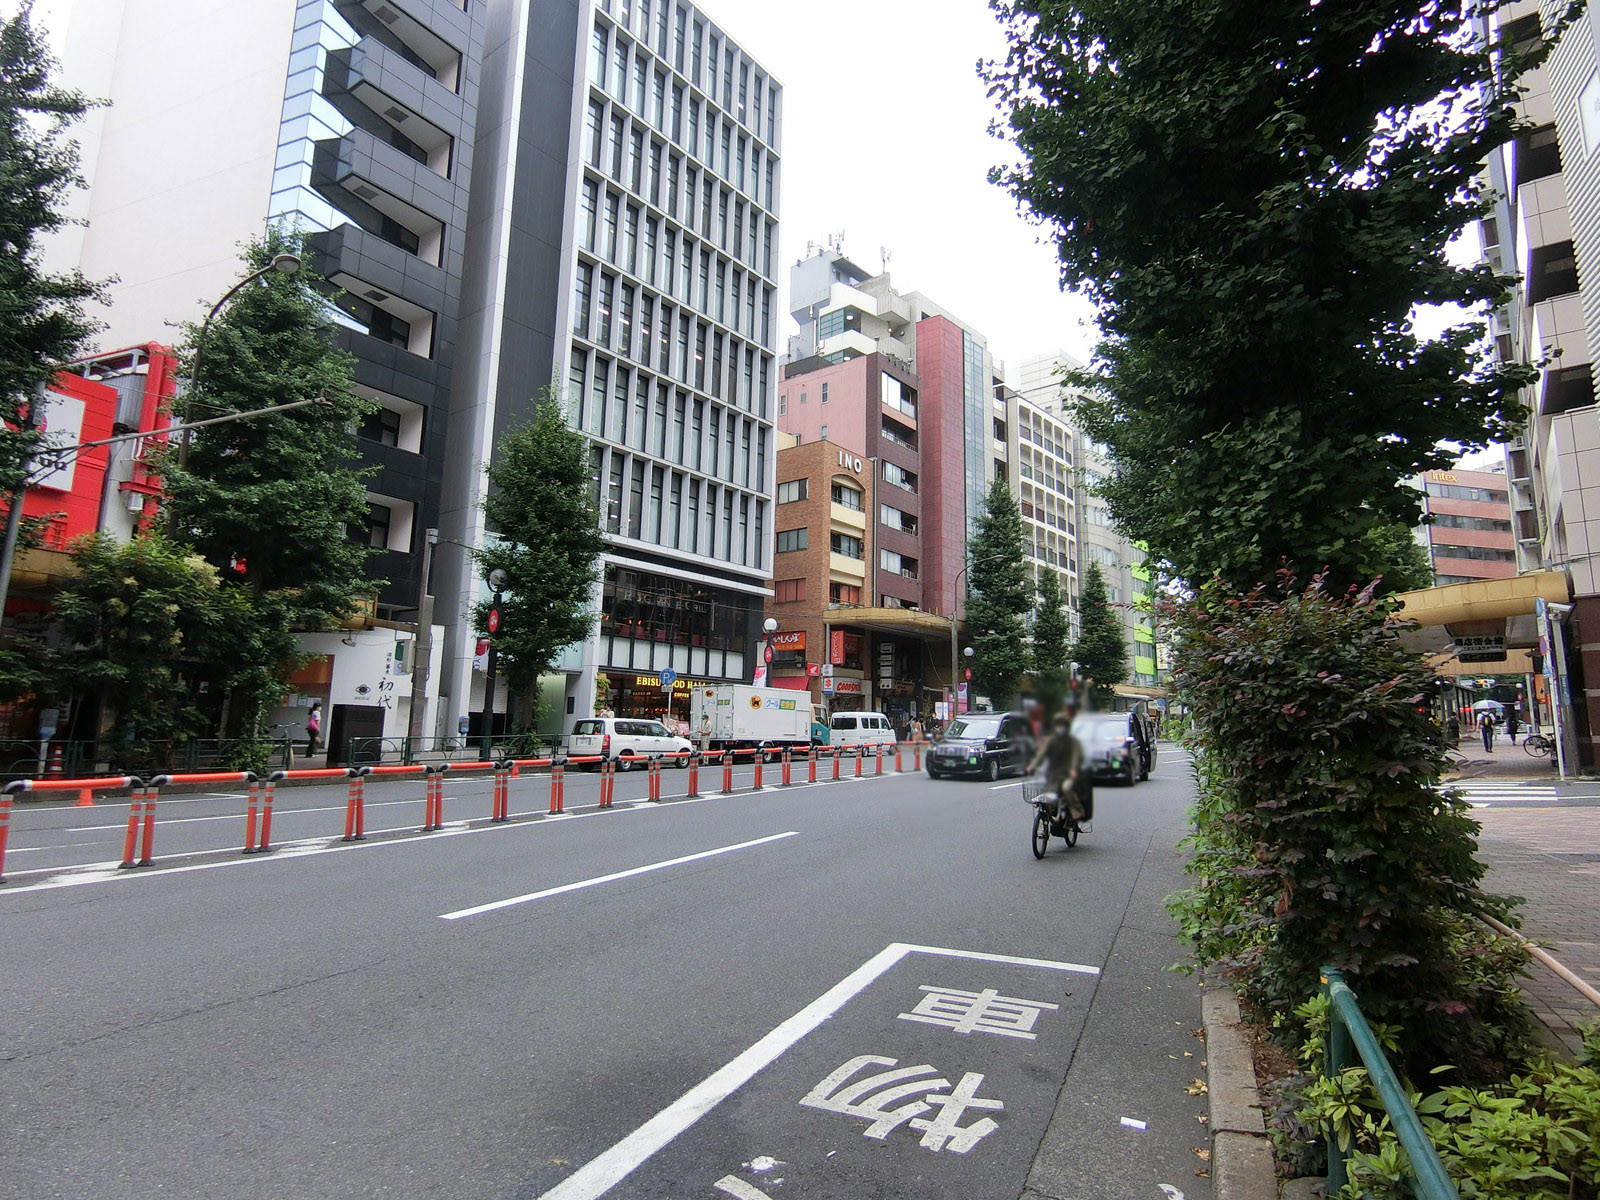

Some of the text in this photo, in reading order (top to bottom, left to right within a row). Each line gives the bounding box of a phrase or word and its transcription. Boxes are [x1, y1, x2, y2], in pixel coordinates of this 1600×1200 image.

[838, 450, 862, 473] INO
[1431, 471, 1457, 482] Intex
[771, 632, 801, 644] いしんぼ
[636, 676, 661, 687] EBISU
[663, 672, 671, 684] P
